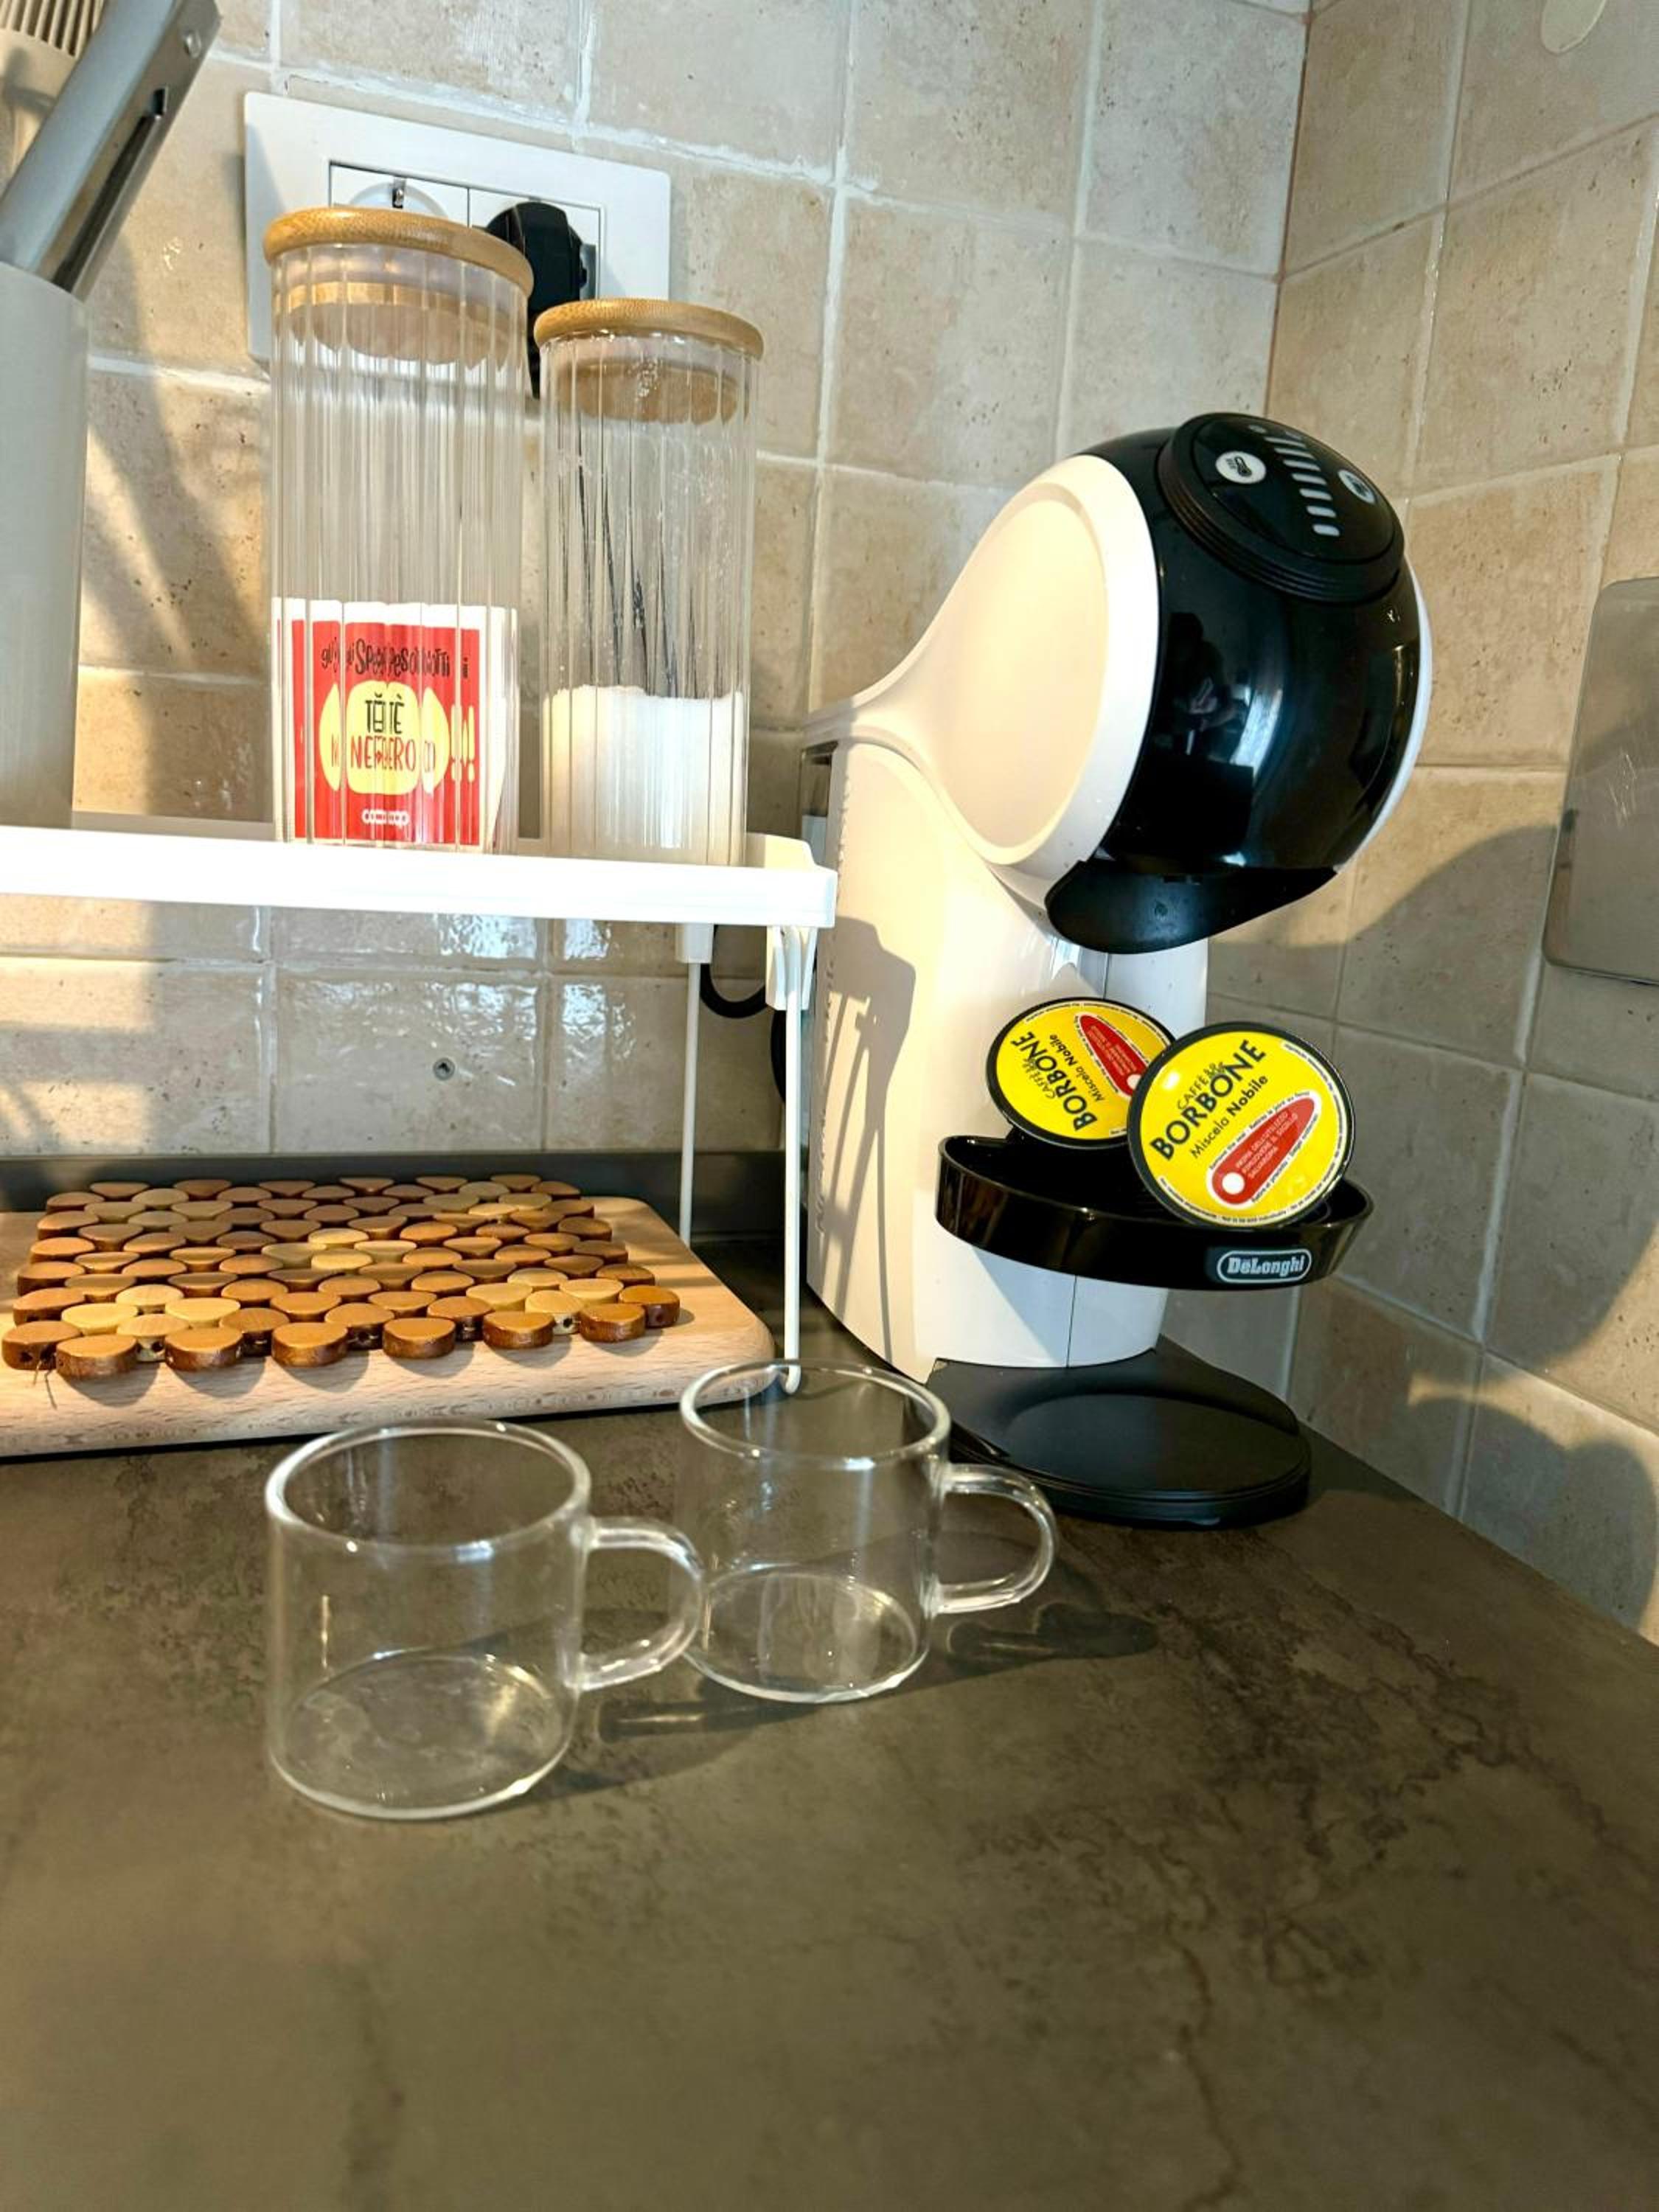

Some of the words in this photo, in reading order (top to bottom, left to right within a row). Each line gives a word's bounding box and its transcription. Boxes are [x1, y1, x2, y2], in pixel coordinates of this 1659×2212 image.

[1011, 1032, 1098, 1132] BORBONE
[1049, 1034, 1077, 1066] Nobile
[1076, 1066, 1106, 1102] Miscela
[1150, 1039, 1267, 1161] BORBONE
[1190, 1115, 1230, 1159] Miscela
[1226, 1075, 1268, 1117] Nobile
